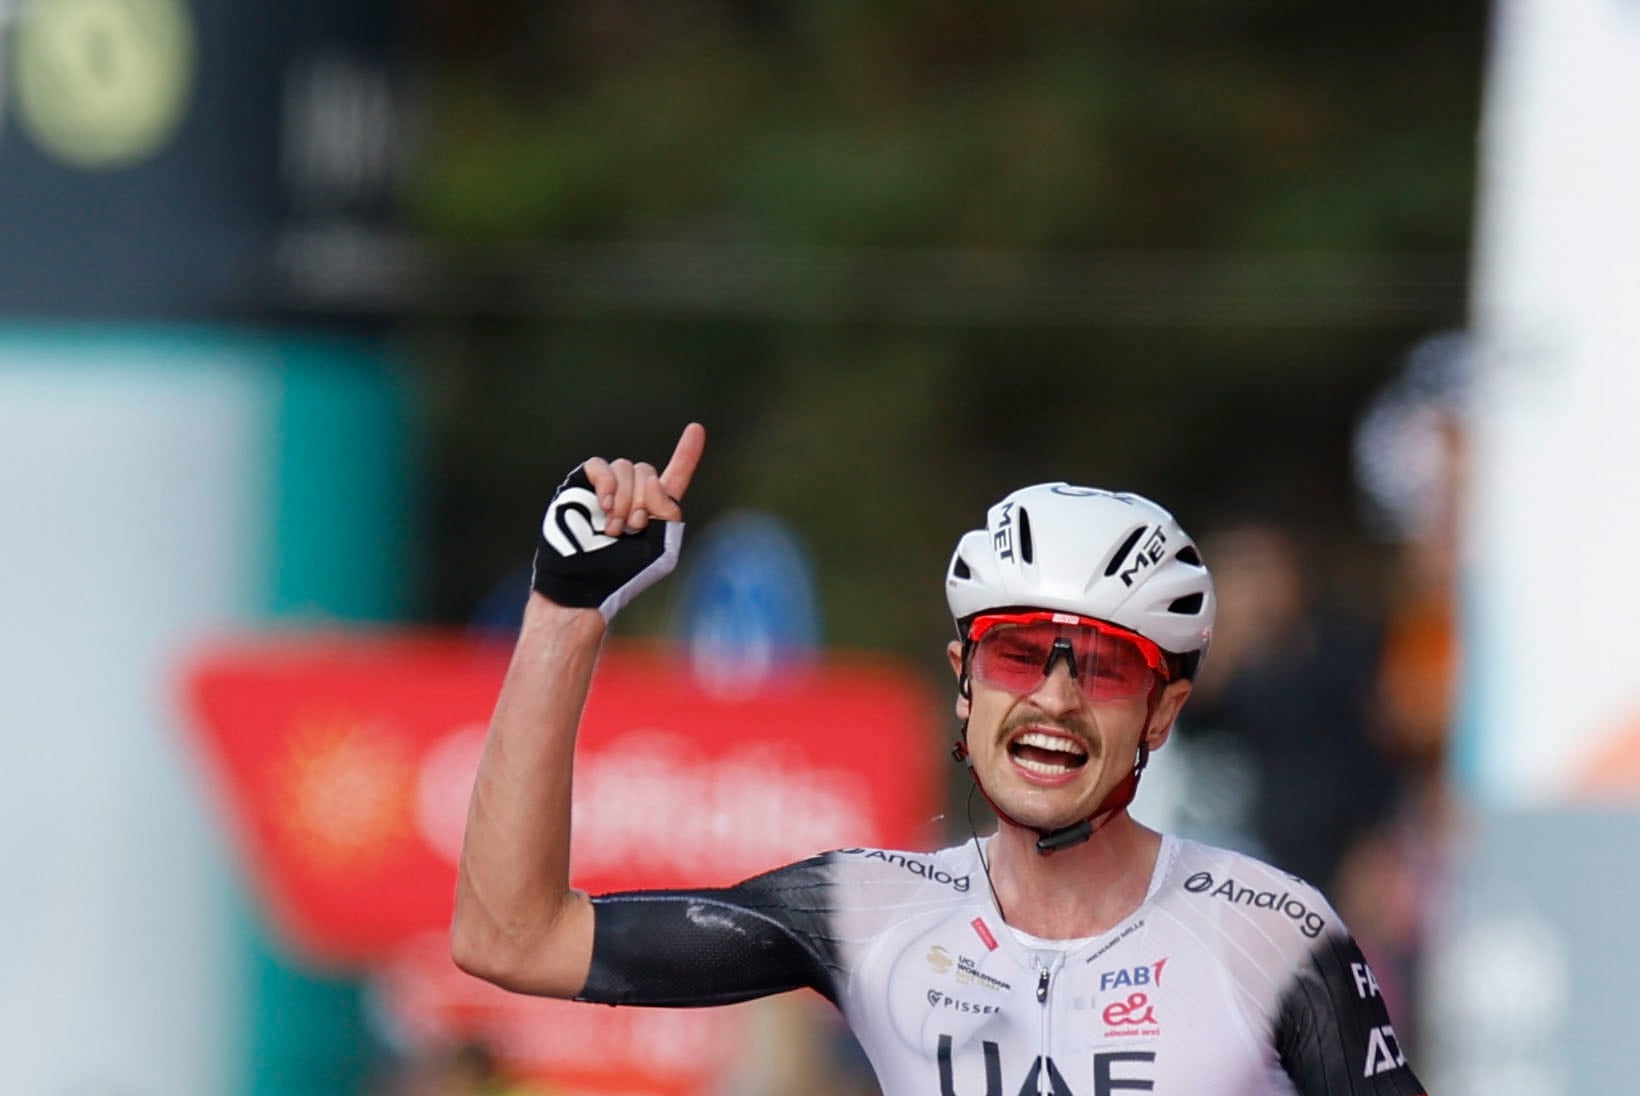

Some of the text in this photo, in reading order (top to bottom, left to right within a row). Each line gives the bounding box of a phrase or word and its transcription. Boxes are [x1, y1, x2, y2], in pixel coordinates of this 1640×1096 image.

[994, 500, 1015, 565] MET
[1118, 524, 1168, 588] MET
[865, 850, 970, 893] Analog
[1211, 878, 1326, 939] Analog
[958, 955, 975, 968] UCI
[1099, 966, 1151, 991] FAB
